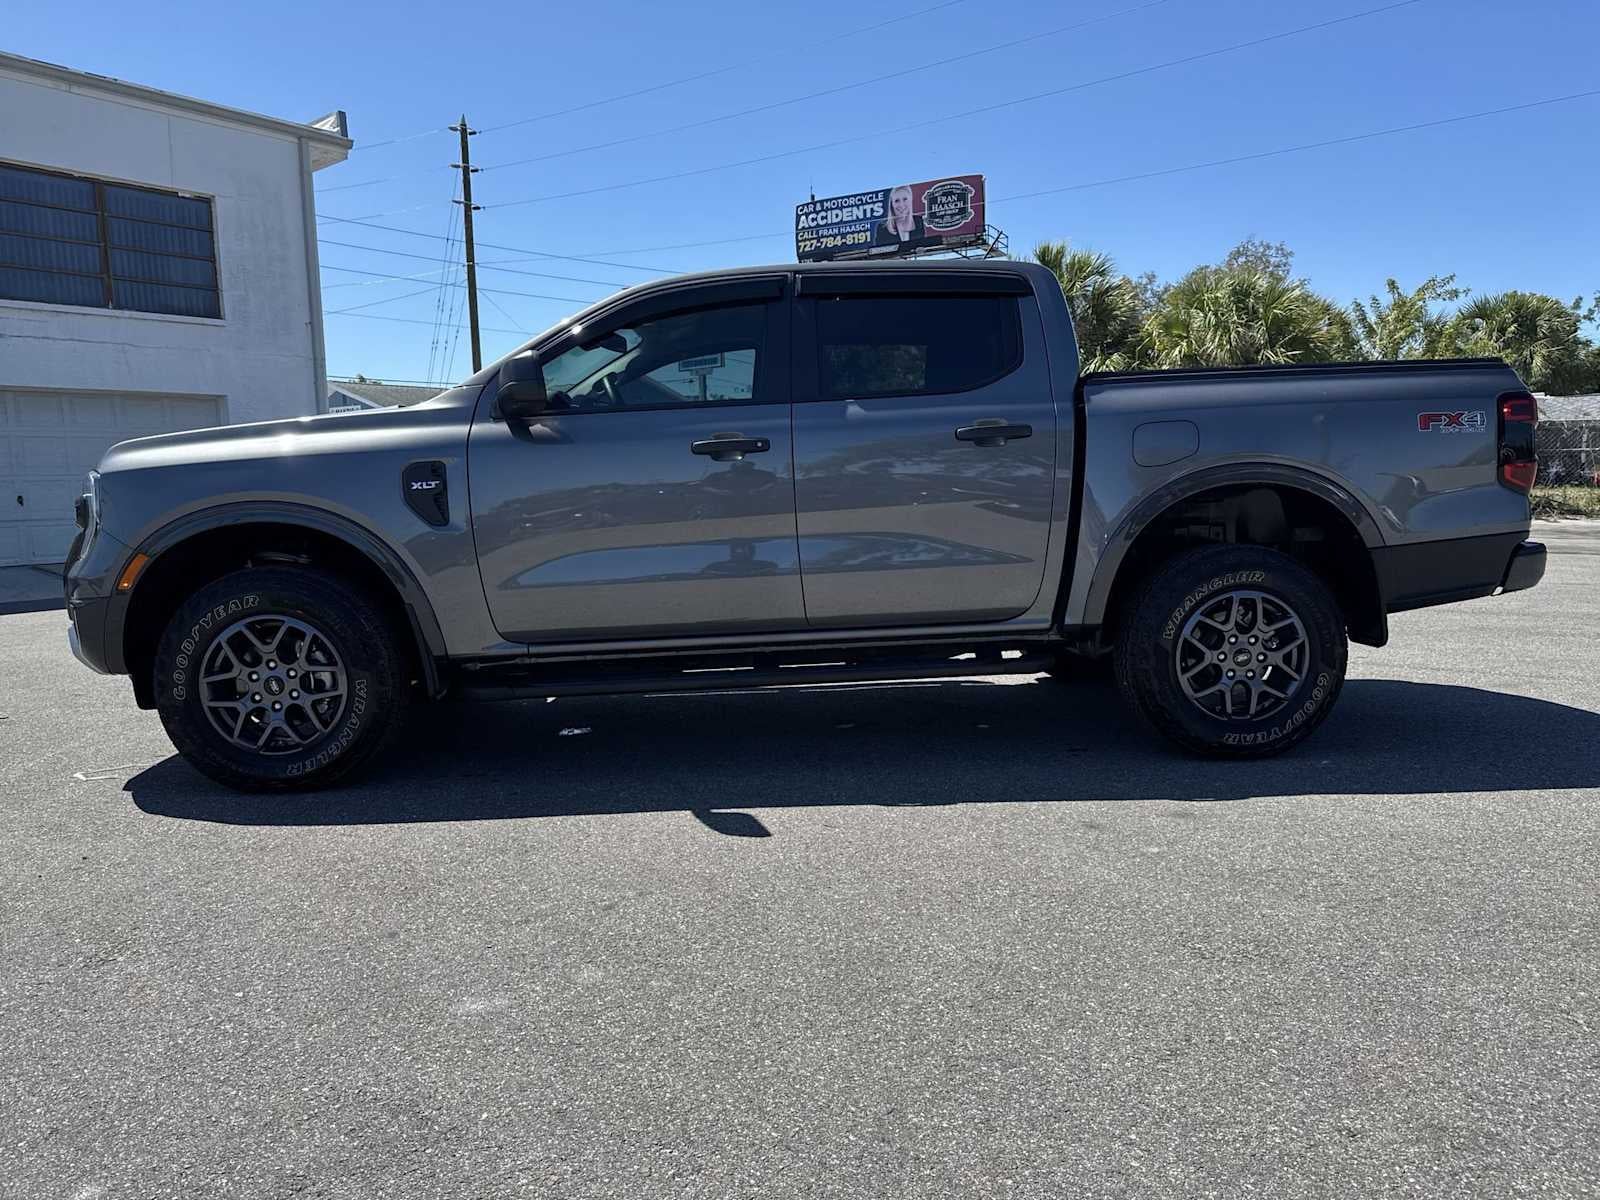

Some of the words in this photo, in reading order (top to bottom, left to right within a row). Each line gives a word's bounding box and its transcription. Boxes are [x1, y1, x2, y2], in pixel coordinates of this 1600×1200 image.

[798, 204, 814, 215] CAR
[816, 203, 822, 211] &
[824, 192, 884, 210] MOTORCYCLE
[931, 201, 965, 212] HAASCH
[937, 194, 958, 204] FRAN
[798, 202, 884, 230] ACCIDENTS
[798, 230, 818, 241] CALL
[818, 227, 839, 237] FRAN
[840, 223, 871, 234] HAASCH
[798, 231, 871, 253] 727-784-8191
[1417, 410, 1487, 432] FX4
[411, 481, 441, 490] XLT
[1162, 570, 1265, 641] WRANGLER
[173, 593, 260, 700] GOODYEAR
[1223, 672, 1332, 745] GOODYEAR
[286, 679, 369, 777] WRANGLER
